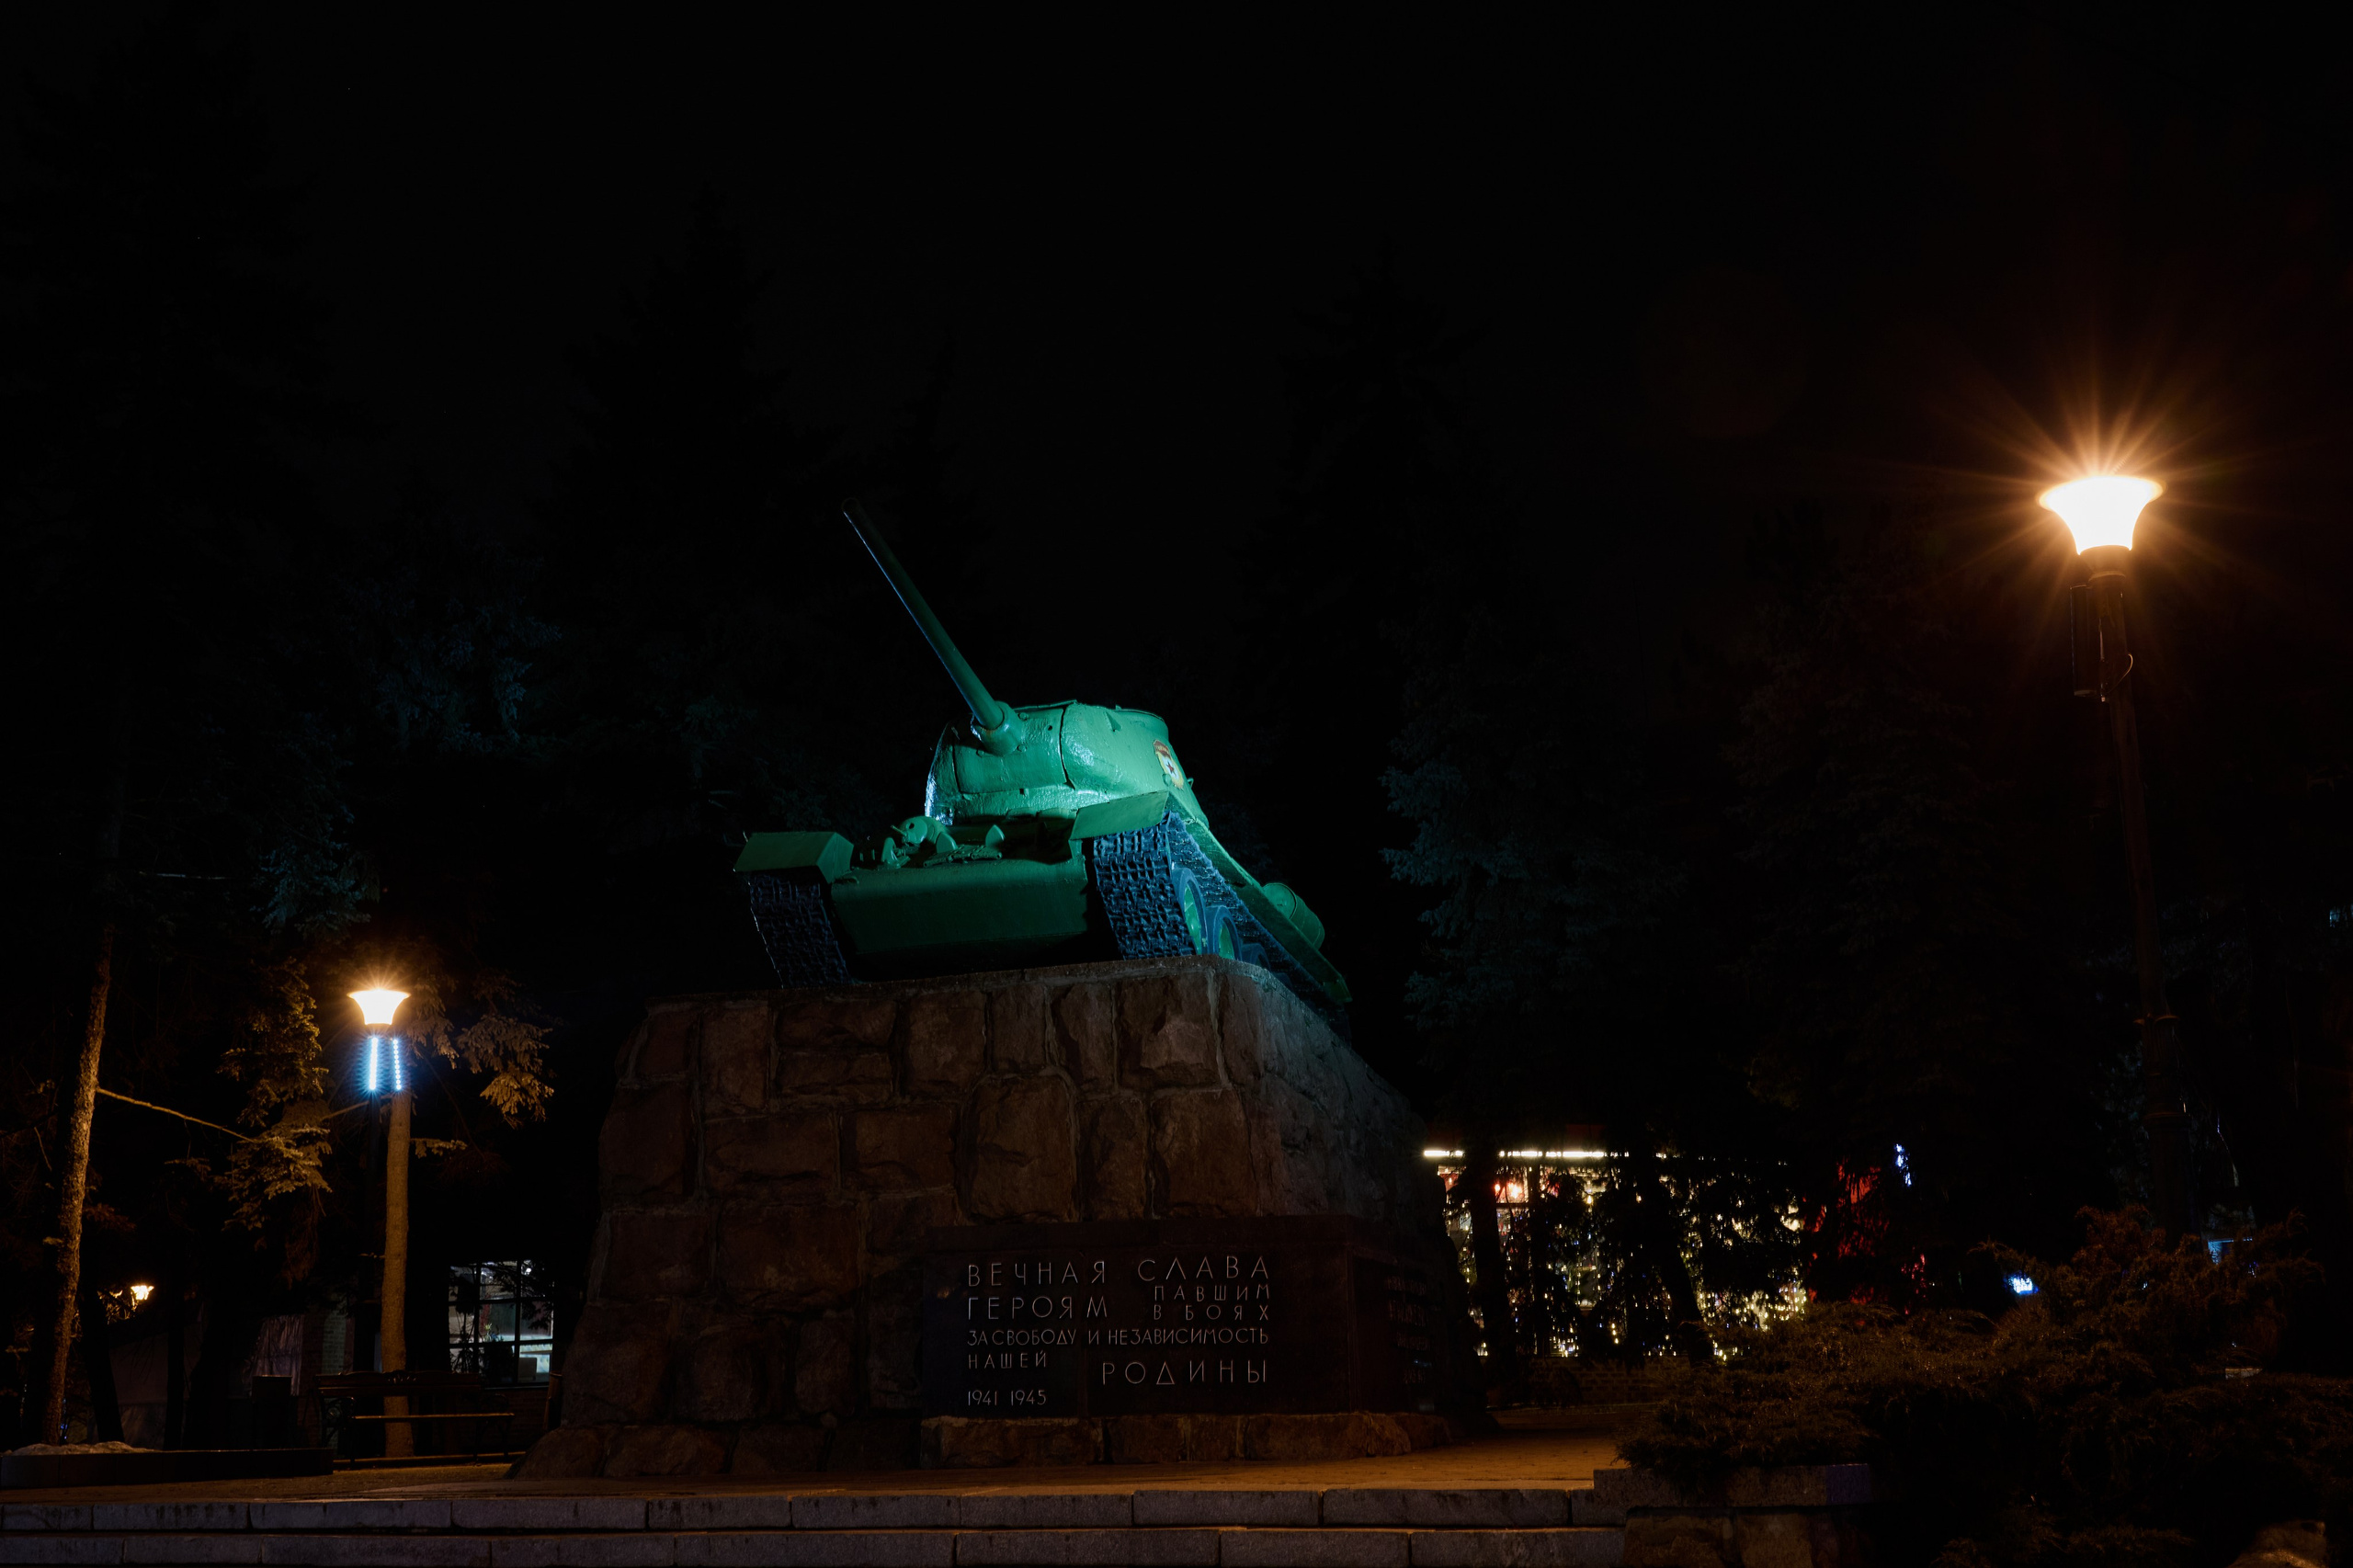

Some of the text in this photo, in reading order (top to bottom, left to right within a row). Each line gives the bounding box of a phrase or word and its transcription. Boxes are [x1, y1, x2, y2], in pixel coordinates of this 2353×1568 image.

[968, 1256, 1269, 1287] ВЕЧНАЯ СЛАВА
[1154, 1284, 1270, 1302] ПАВШИМ
[968, 1295, 1108, 1320] ГЕРОЯМ
[1154, 1304, 1269, 1322] В БОЯХ
[1088, 1330, 1100, 1346] И
[1108, 1327, 1269, 1346] НЕЗАВИСИМОСТЬ
[968, 1350, 1048, 1369] НАШЕЙ
[1102, 1359, 1267, 1386] РОДИНЫ
[968, 1389, 1048, 1407] 1941 1945
